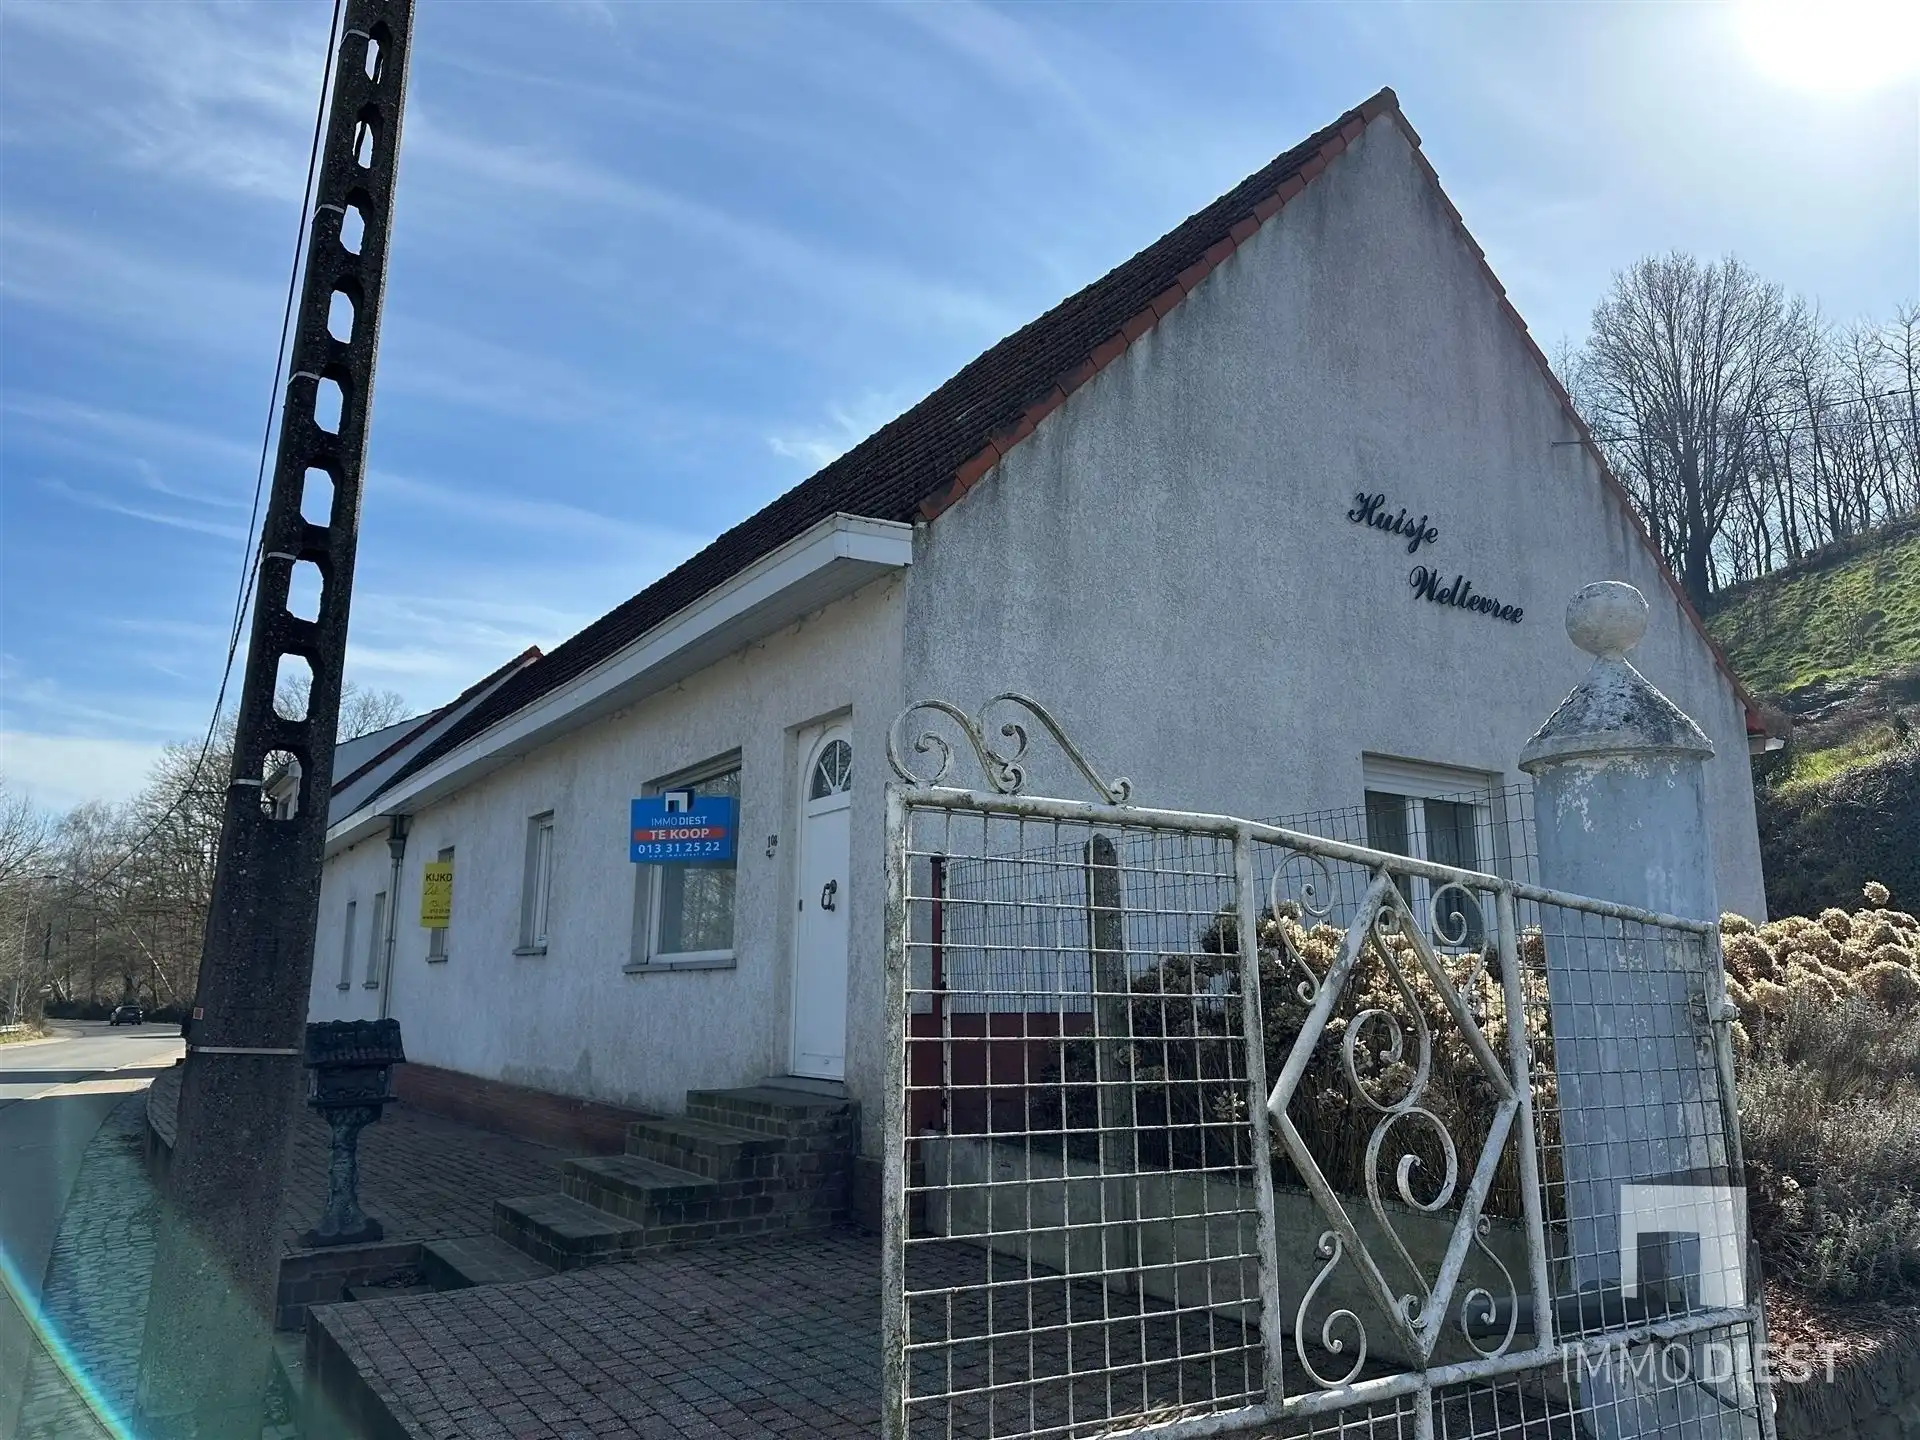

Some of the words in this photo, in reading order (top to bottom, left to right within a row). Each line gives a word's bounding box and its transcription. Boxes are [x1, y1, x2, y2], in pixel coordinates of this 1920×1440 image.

[1347, 492, 1439, 553] Huisje
[1409, 565, 1524, 624] Weltevree
[651, 817, 678, 827] IMMO
[679, 816, 708, 825] DIEST
[648, 830, 666, 840] TE
[670, 828, 710, 839] KOOP
[638, 844, 661, 854] 013
[666, 843, 680, 853] 31
[685, 842, 701, 852] 25
[705, 841, 720, 851] 22
